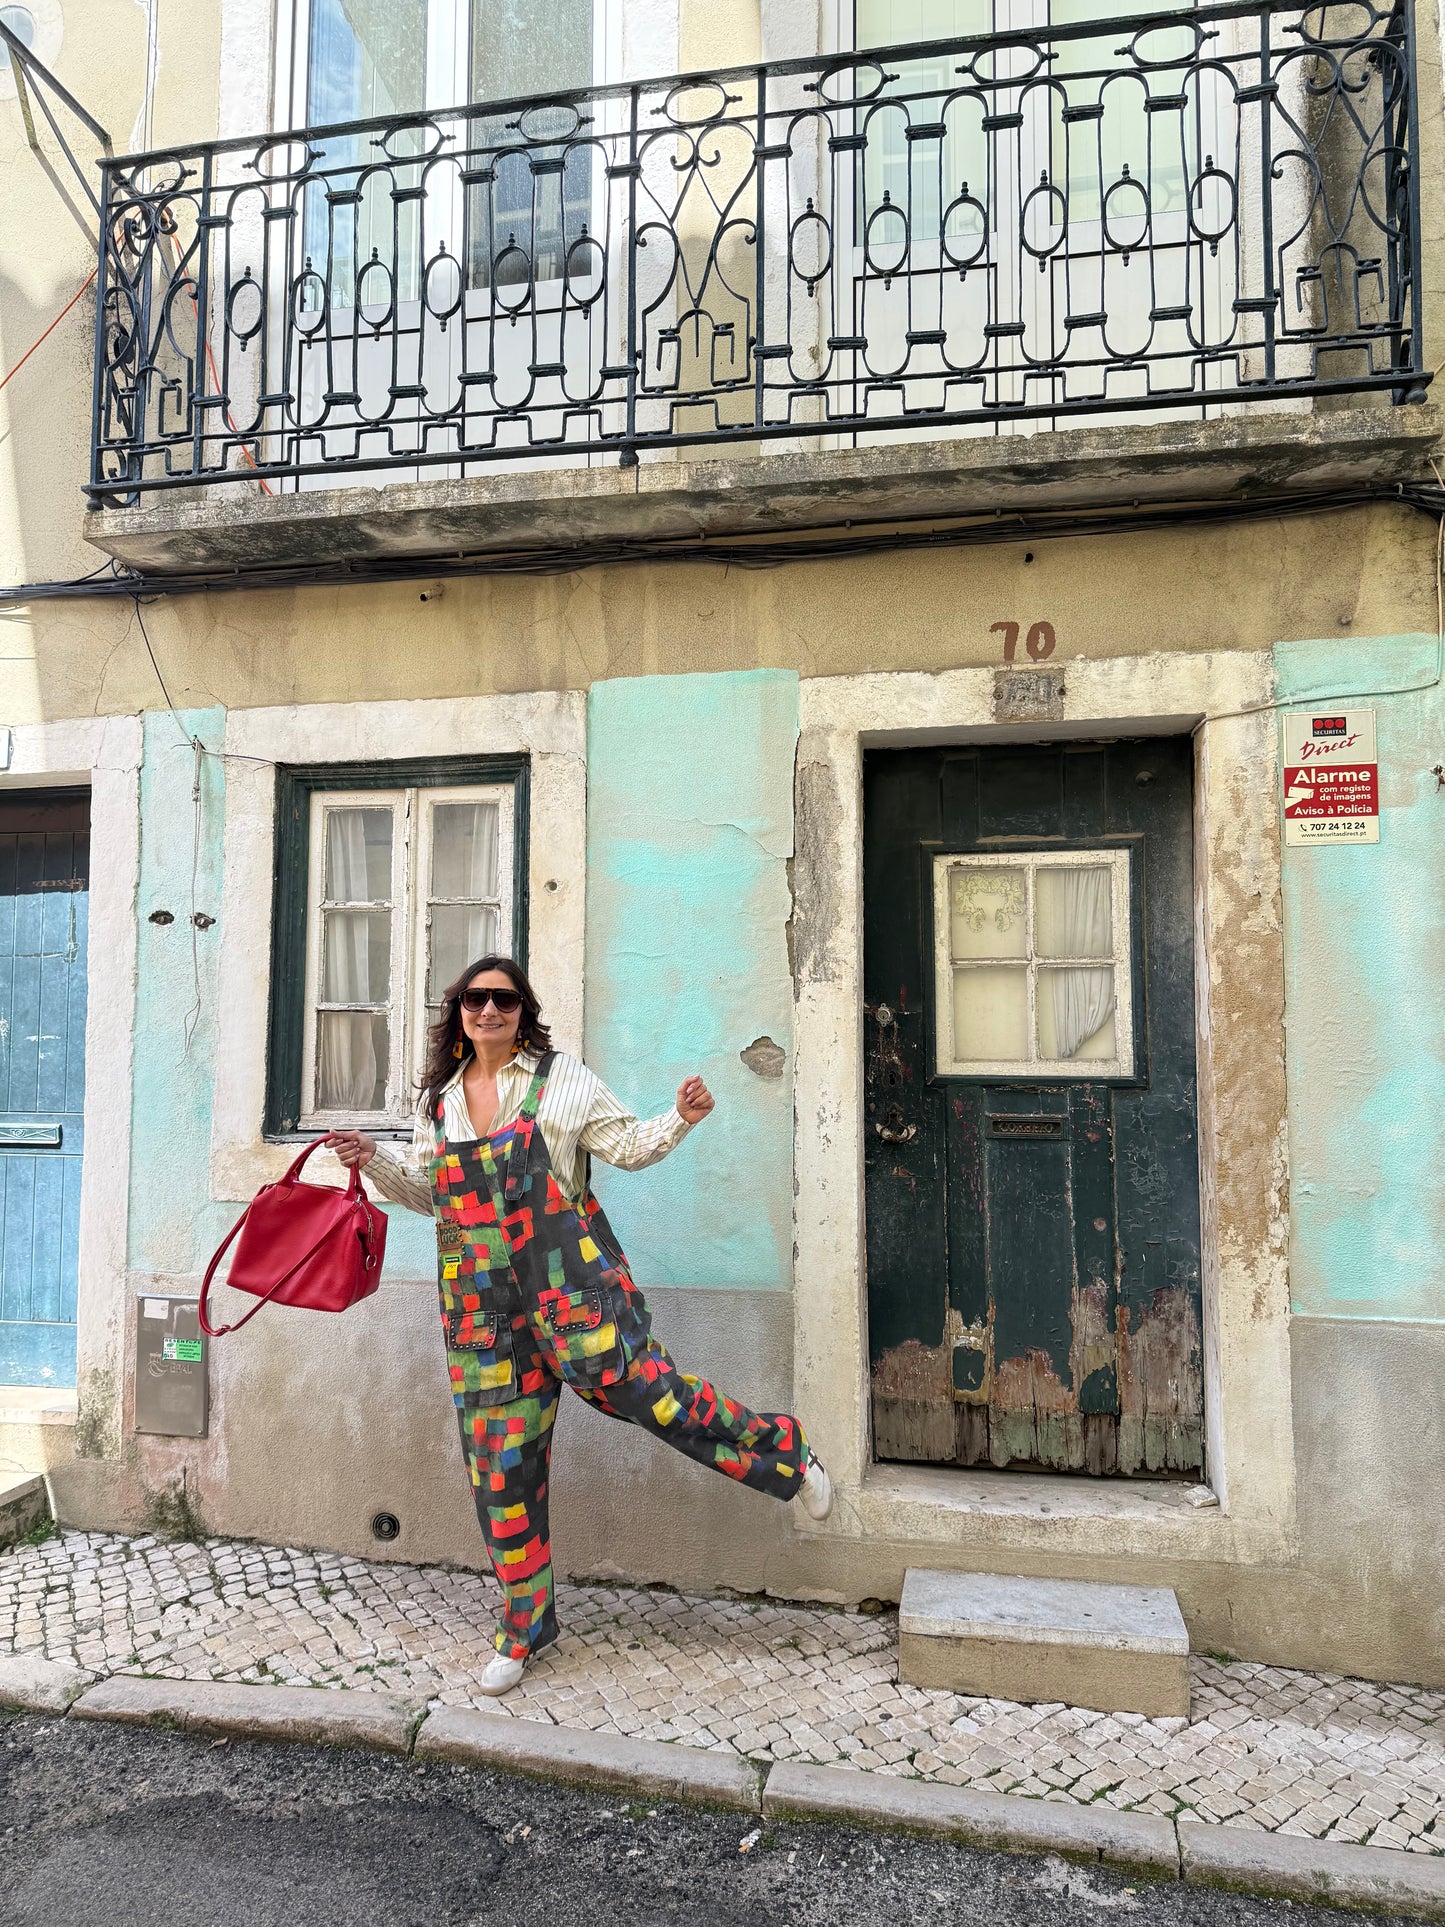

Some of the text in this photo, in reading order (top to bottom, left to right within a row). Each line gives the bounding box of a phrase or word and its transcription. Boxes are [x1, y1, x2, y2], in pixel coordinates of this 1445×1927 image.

[989, 621, 1056, 662] 70
[1300, 733, 1364, 760] Direct
[1293, 768, 1371, 784] Alarme
[1340, 784, 1371, 793] registo
[1319, 793, 1371, 802] de imagens
[1294, 804, 1372, 816] Aviso à Polícia
[1310, 822, 1365, 831] 707 24 12 24
